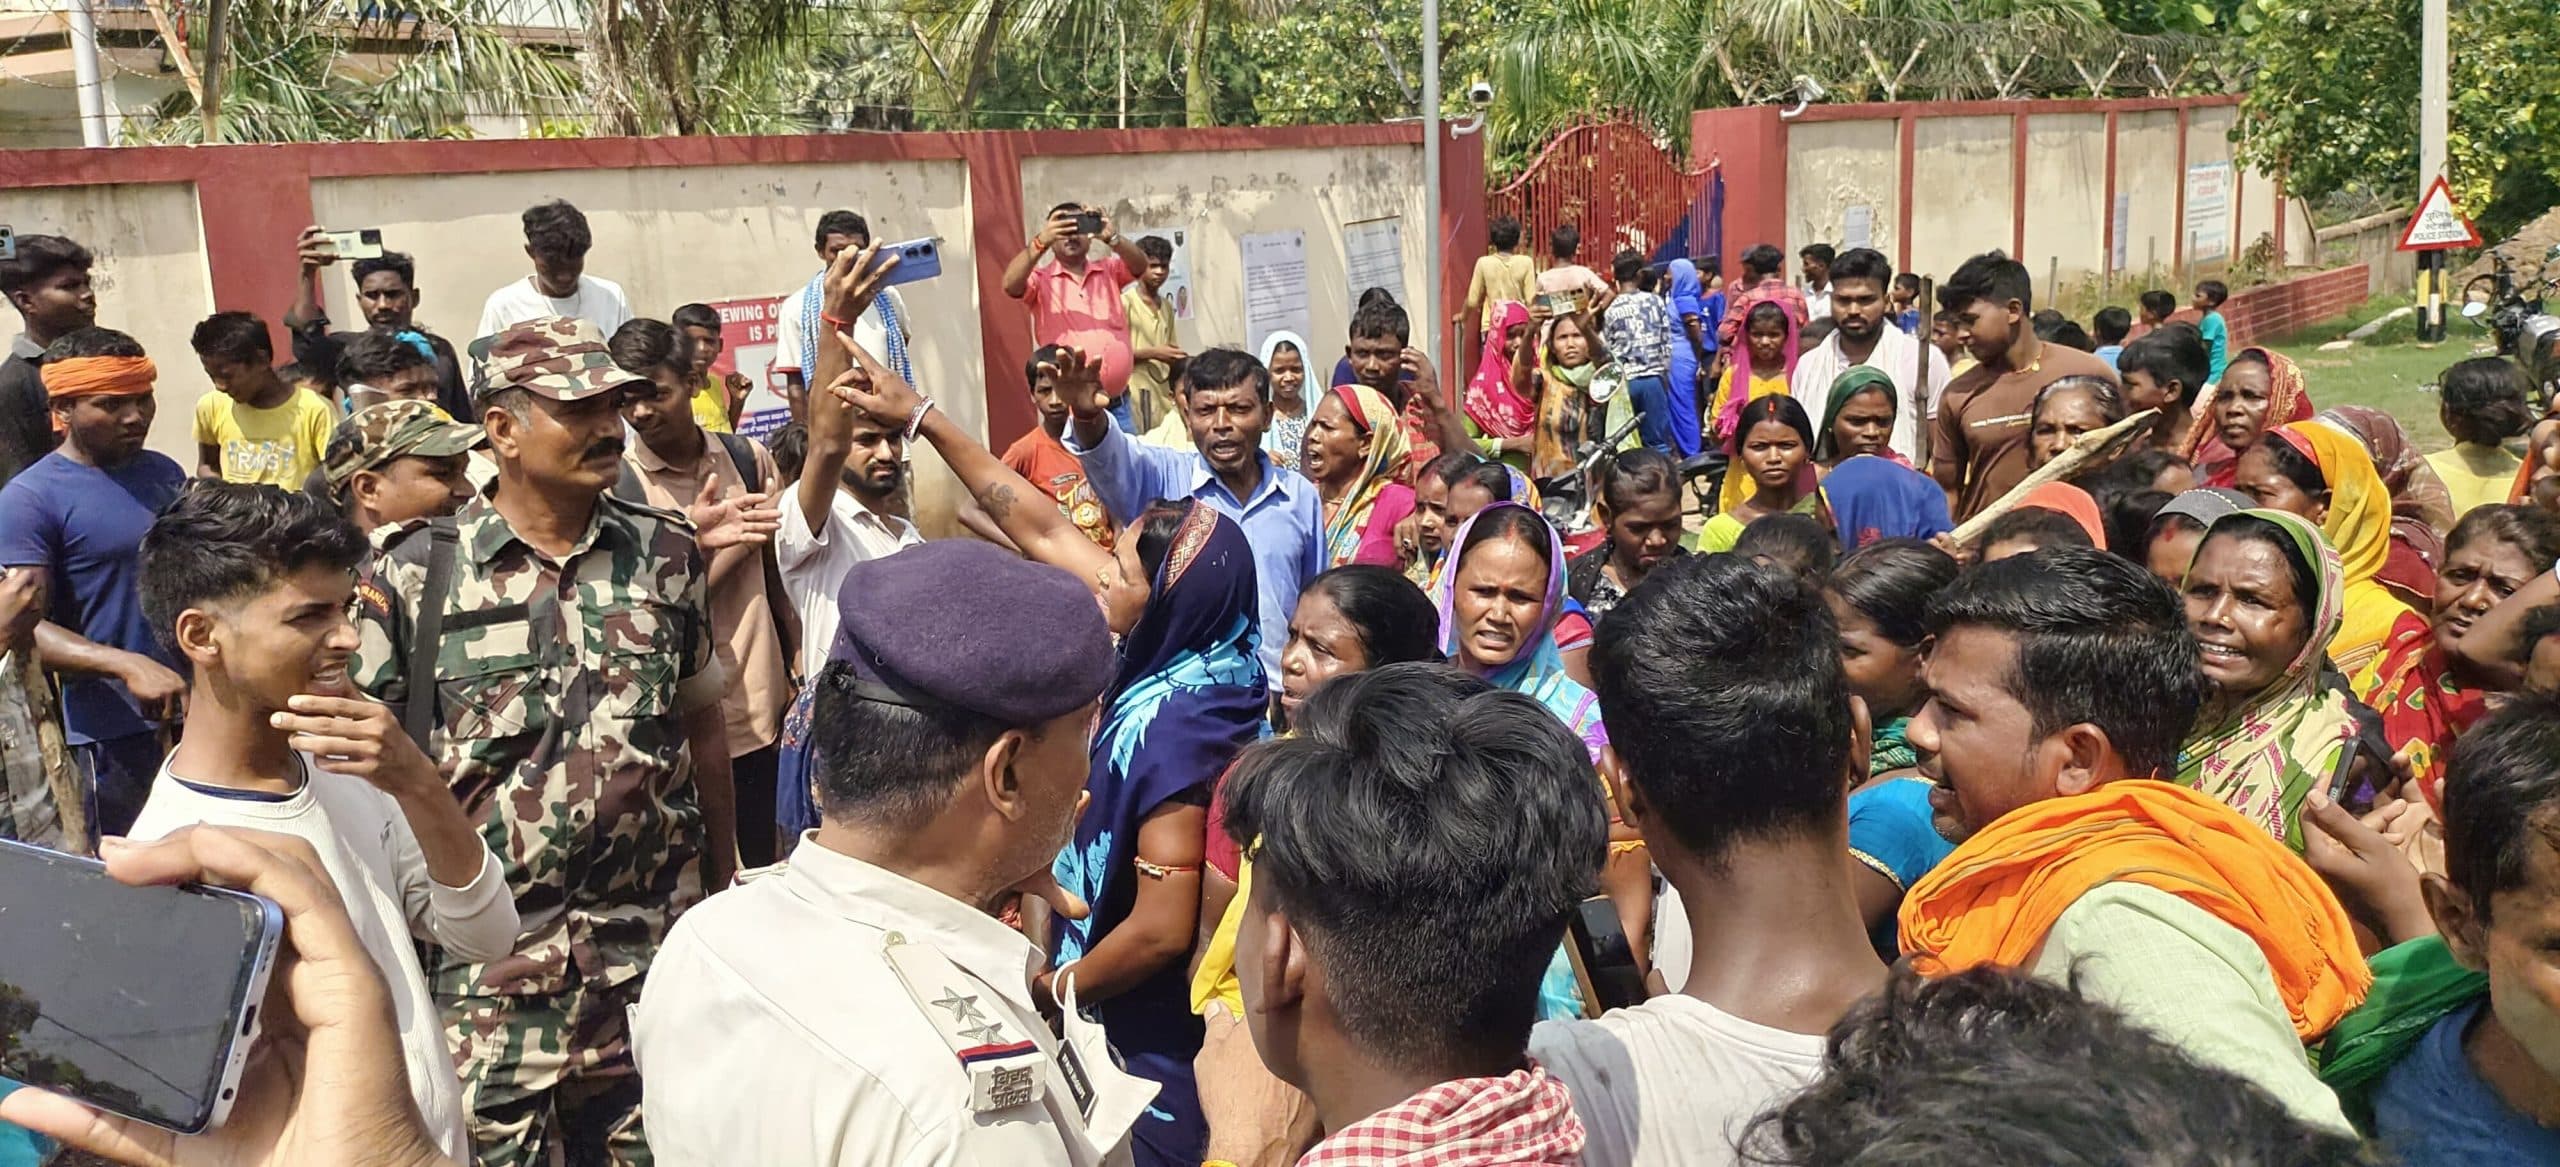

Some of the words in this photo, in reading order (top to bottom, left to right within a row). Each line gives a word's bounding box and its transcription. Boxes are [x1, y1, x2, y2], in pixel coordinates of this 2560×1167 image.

[2414, 231, 2436, 241] POLICE
[2437, 230, 2464, 240] STATION
[716, 304, 764, 324] EWING
[749, 325, 763, 341] IS
